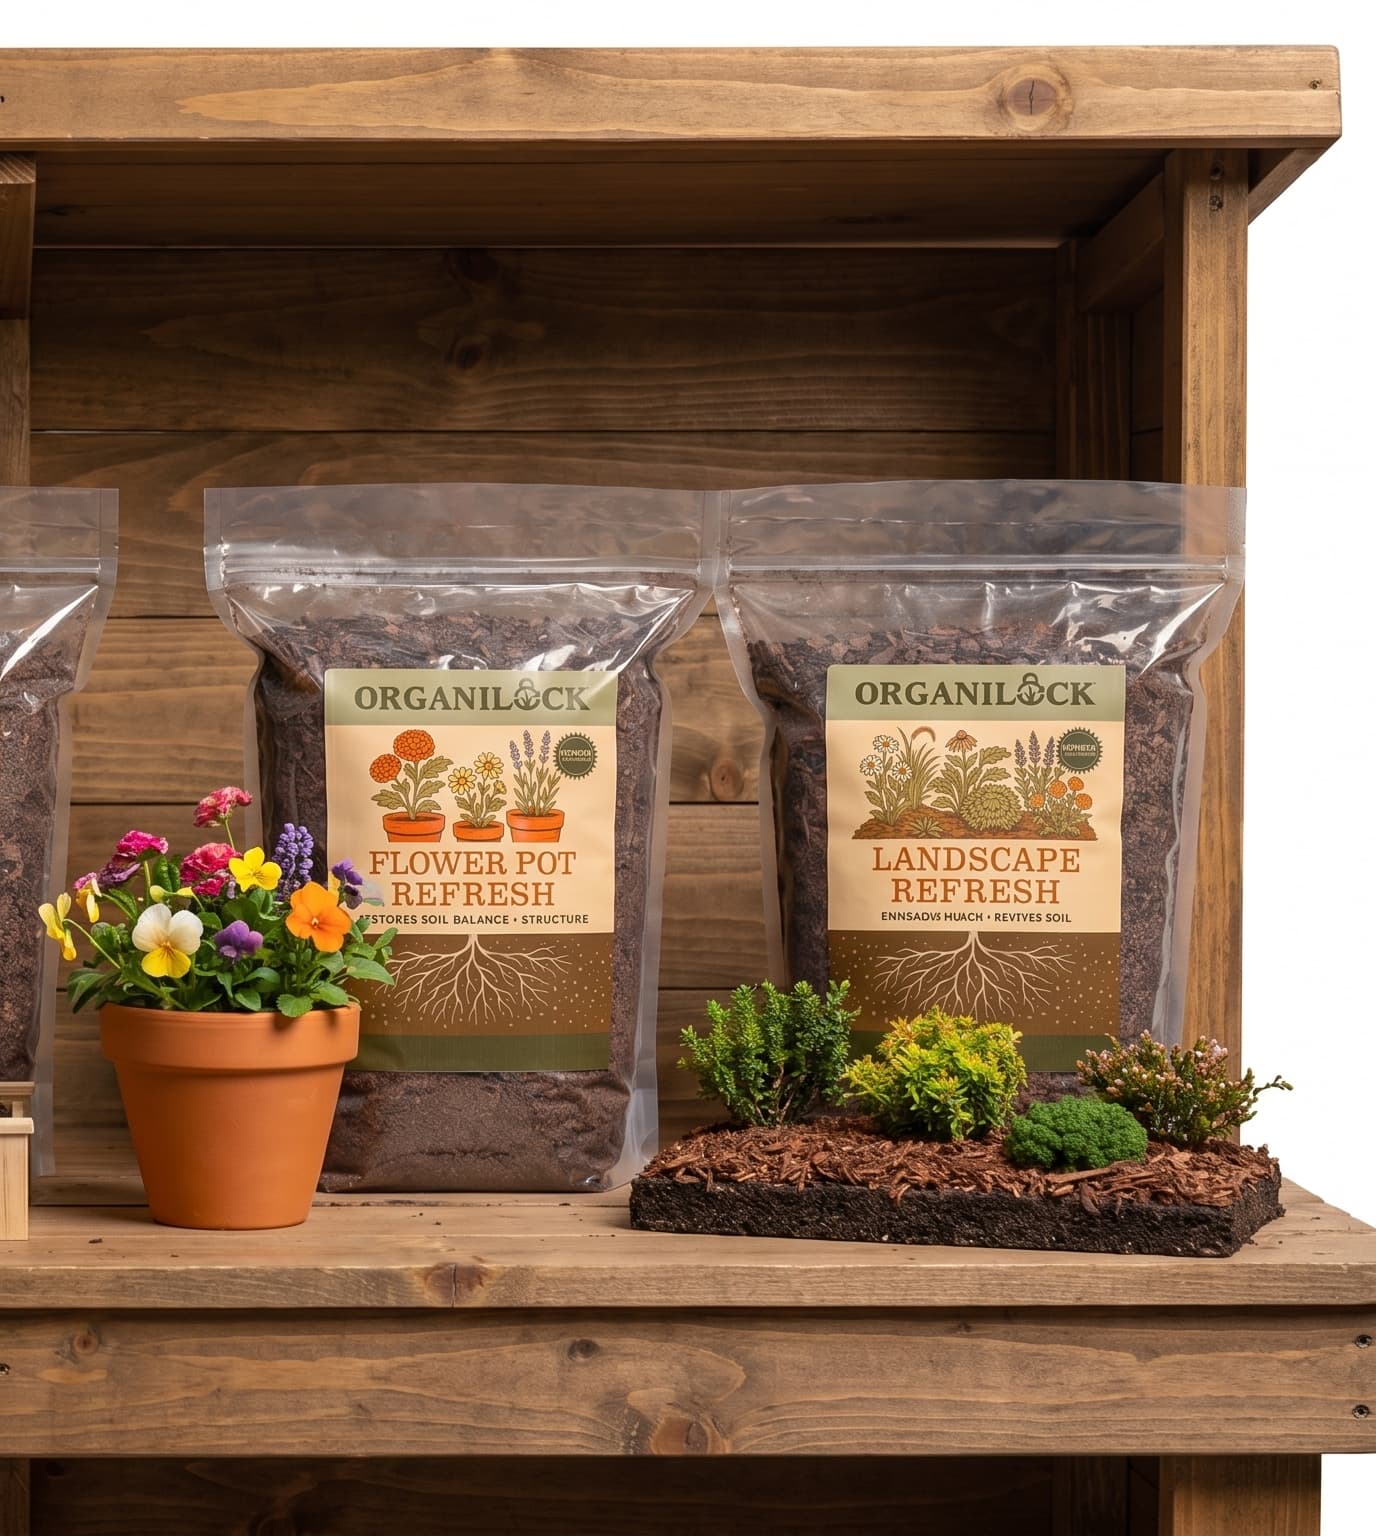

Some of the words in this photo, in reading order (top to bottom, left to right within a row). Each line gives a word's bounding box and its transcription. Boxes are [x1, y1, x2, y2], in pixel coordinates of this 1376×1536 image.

[368, 850, 508, 876] FLOWER
[515, 851, 577, 876] POT
[872, 846, 1080, 873] LANDSCAPE
[391, 881, 555, 907] REFRESH
[891, 878, 1060, 904] REFRESH
[359, 914, 418, 925] STORES
[421, 914, 449, 925] SOIL
[453, 915, 509, 925] BALANCE
[521, 914, 589, 925] STRUCTURE
[1045, 913, 1072, 923] SOIL
